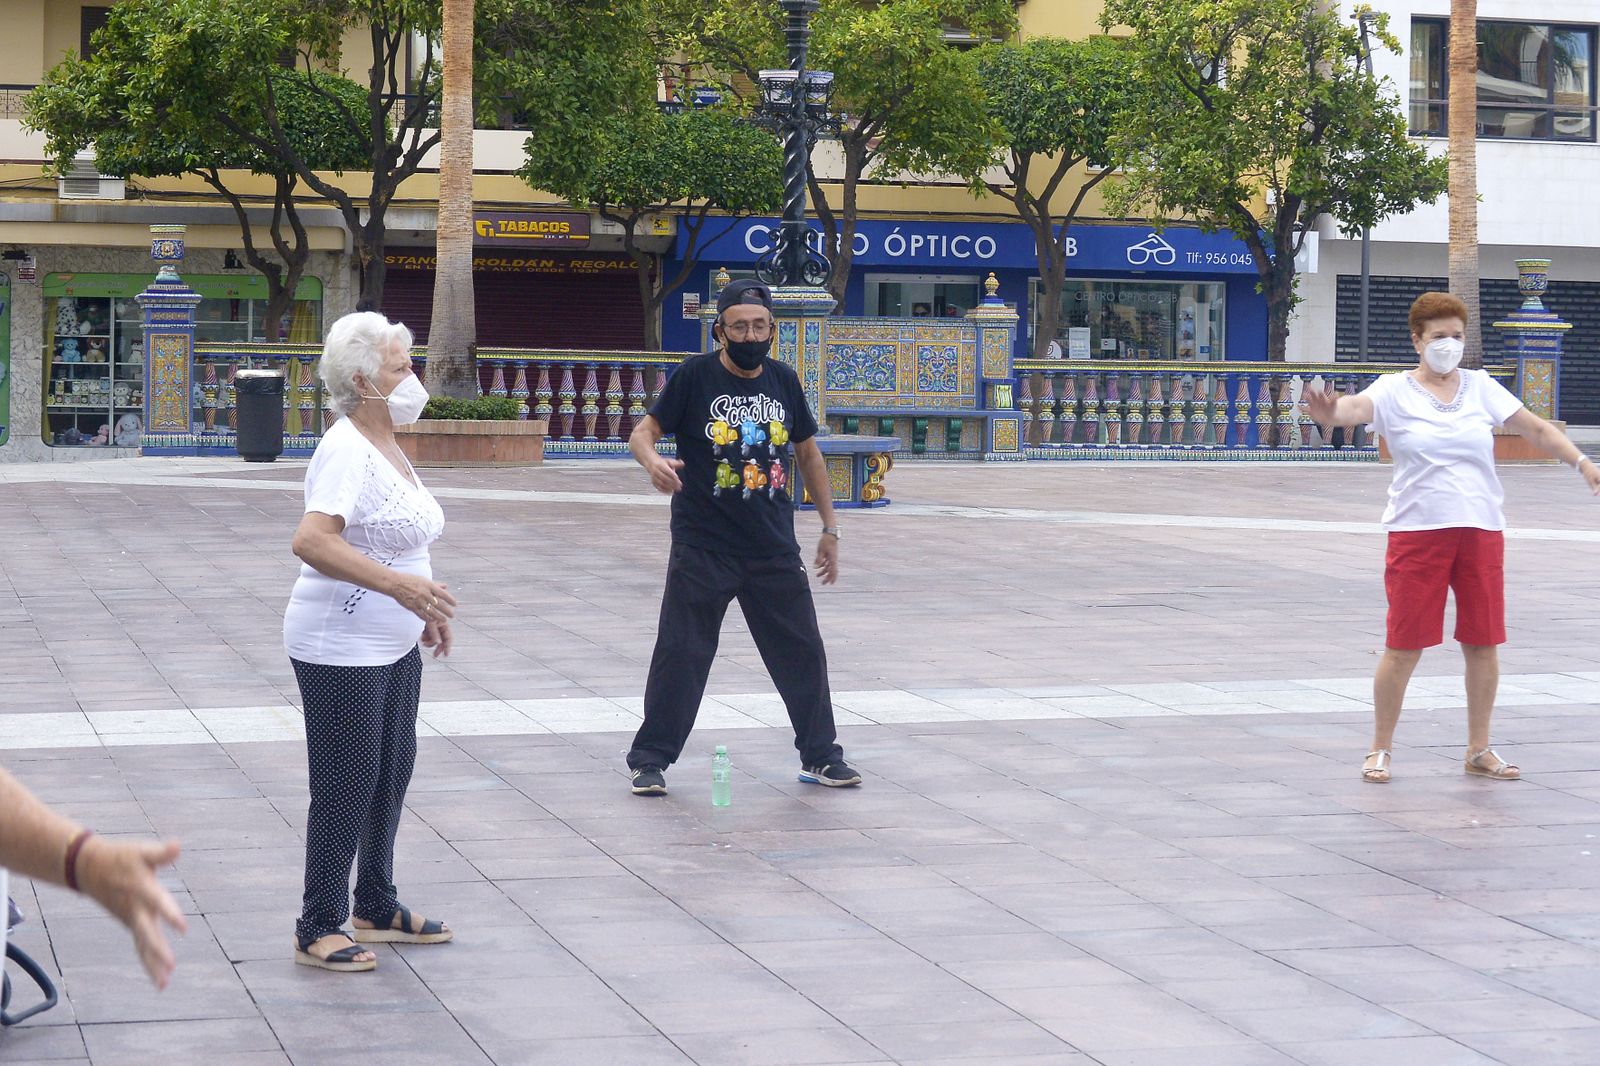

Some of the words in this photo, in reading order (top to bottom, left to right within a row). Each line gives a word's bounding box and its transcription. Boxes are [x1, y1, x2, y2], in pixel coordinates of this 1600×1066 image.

[498, 220, 571, 233] TABACOS
[884, 227, 997, 259] ÓPTICO
[1186, 252, 1202, 264] Tlf:
[1205, 252, 1228, 265] 956
[1230, 253, 1253, 266] 045
